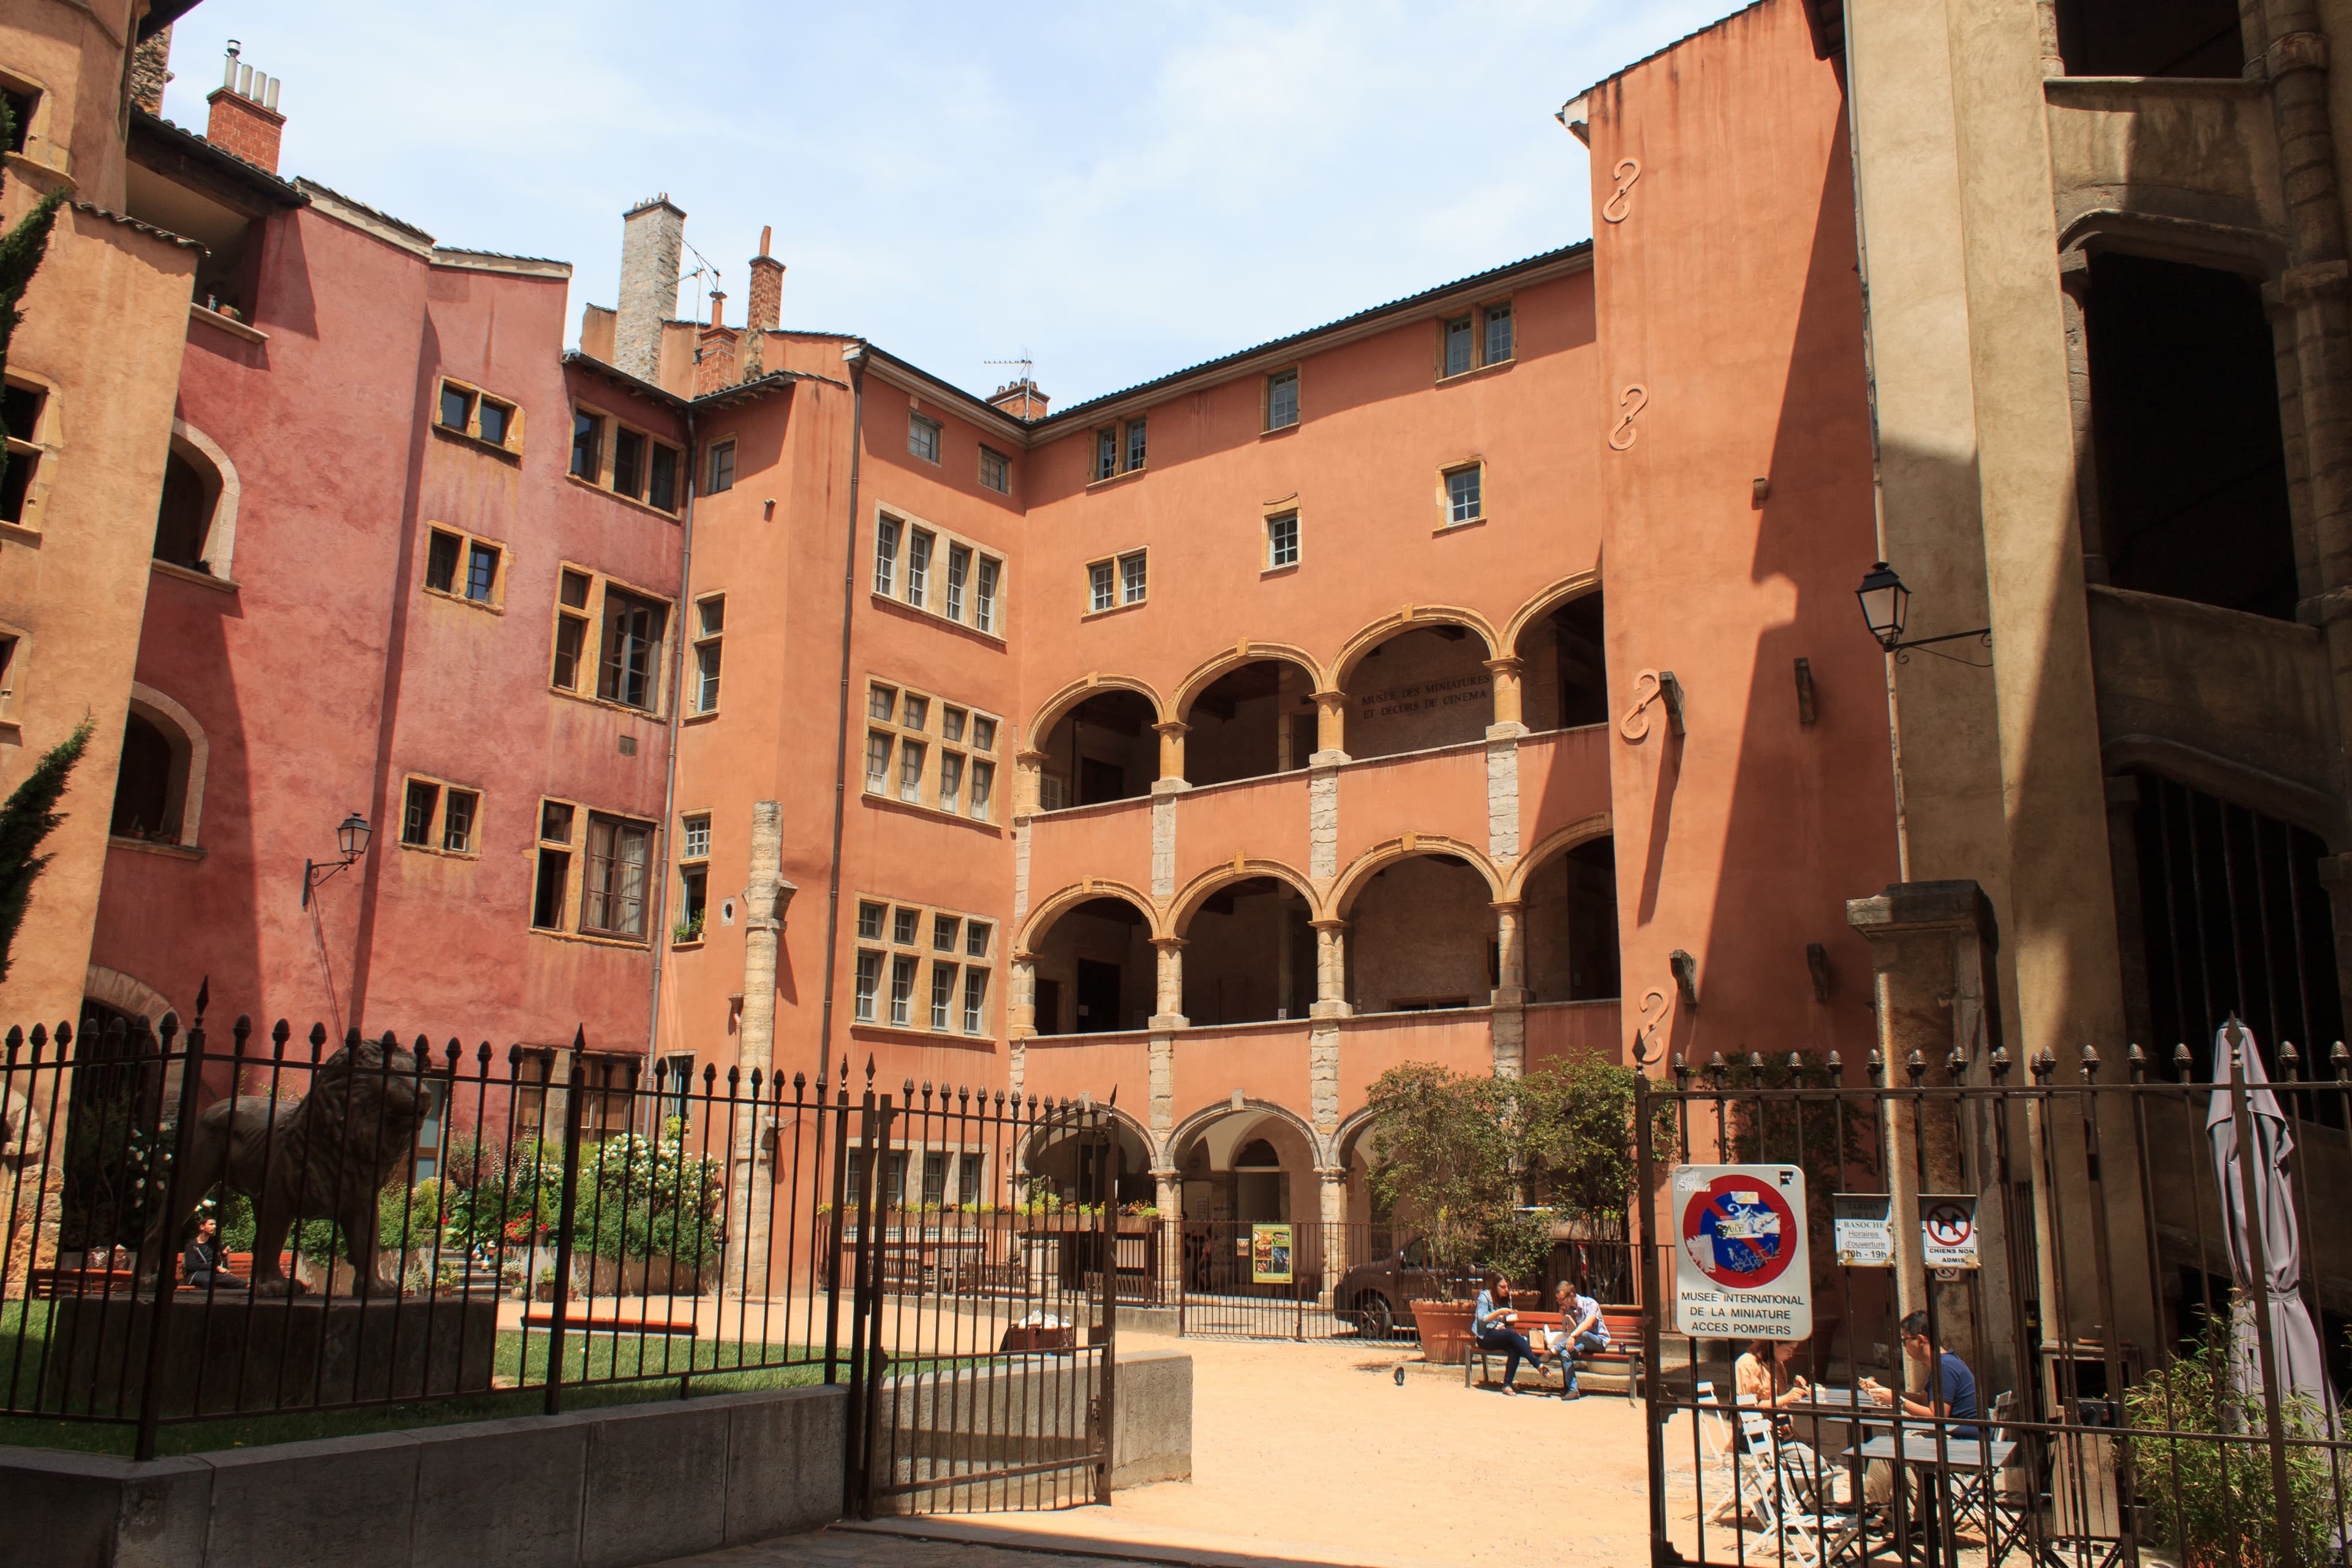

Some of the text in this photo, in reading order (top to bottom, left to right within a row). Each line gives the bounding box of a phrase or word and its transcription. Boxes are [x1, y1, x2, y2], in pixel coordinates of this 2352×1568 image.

[1362, 674, 1490, 706] MUSEE DES MINIATURES
[1363, 690, 1487, 719] ET DECORS DE CINEMA
[1681, 1292, 1804, 1305] MUSEE INTERNATIONAL
[1690, 1306, 1791, 1319] DE LA MINIATURE
[1692, 1322, 1790, 1335] ACCES POMPIERS
